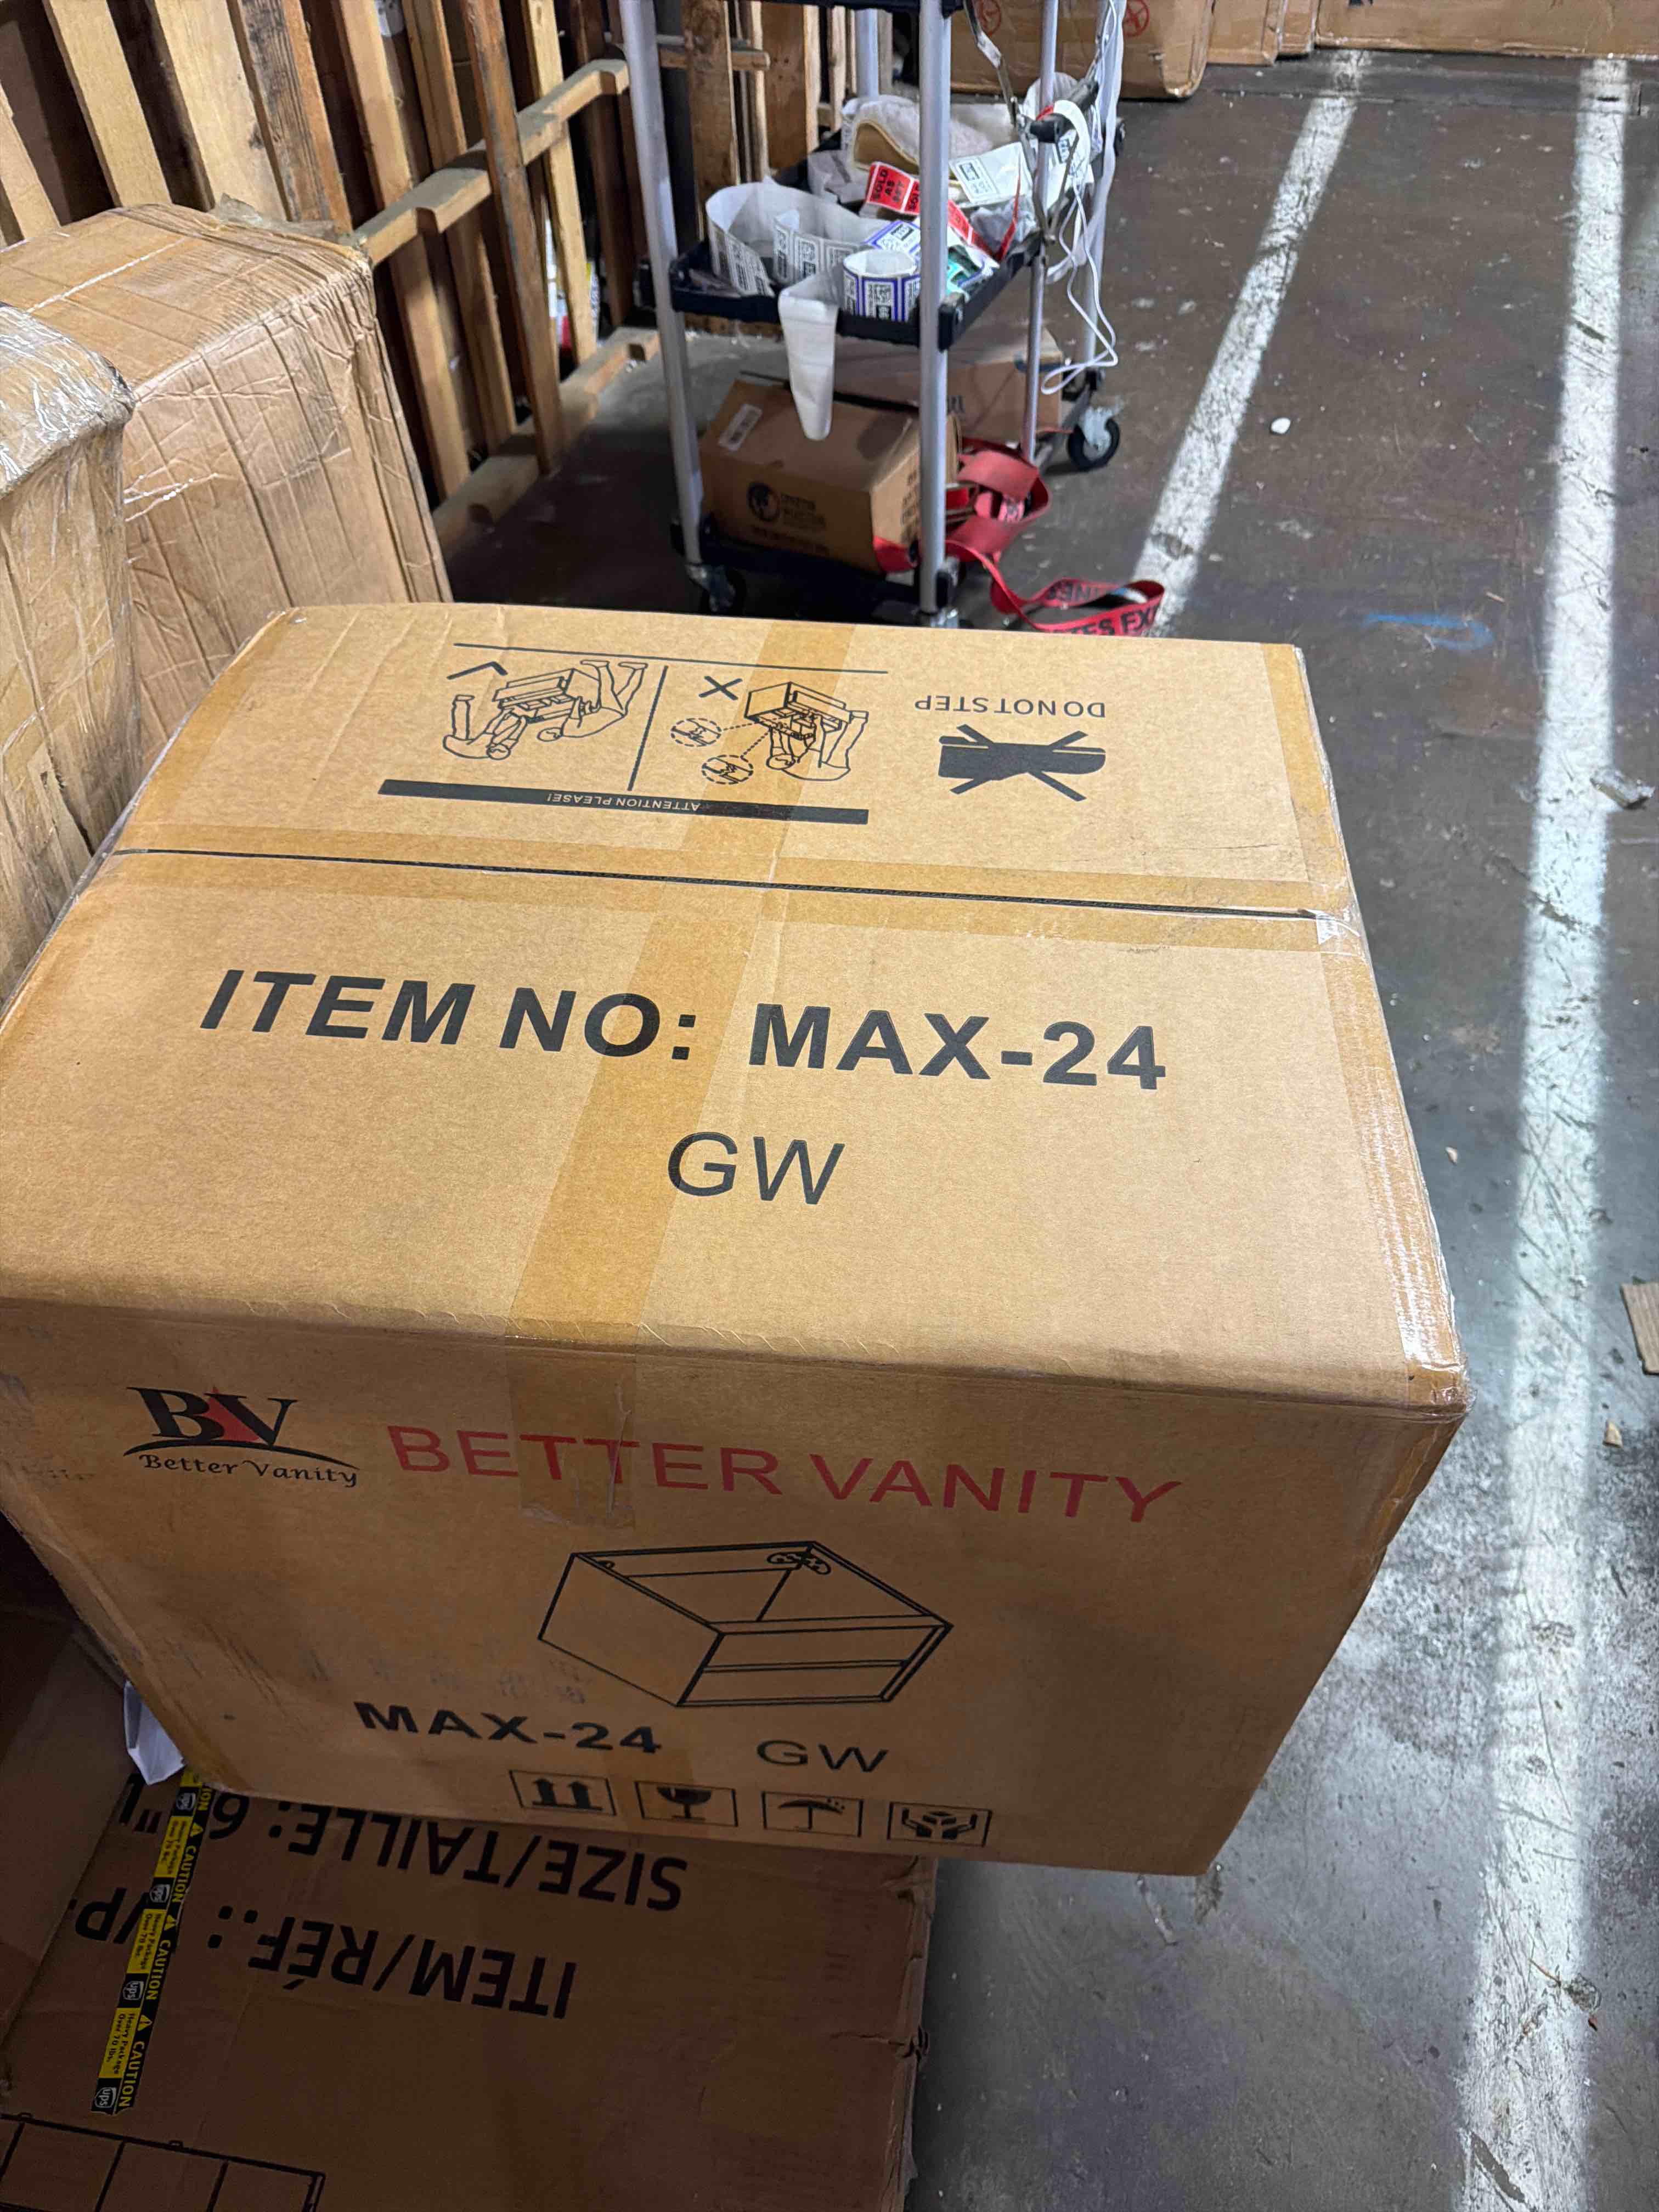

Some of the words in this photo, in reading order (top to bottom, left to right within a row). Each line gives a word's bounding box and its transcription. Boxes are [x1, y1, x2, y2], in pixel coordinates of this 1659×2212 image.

[914, 695, 988, 713] STEP
[994, 697, 1056, 716] NOT
[1063, 700, 1106, 718] DO
[547, 793, 613, 805] PLEASE!
[616, 798, 701, 811] ATTENTION
[199, 968, 476, 1046] ITEM
[499, 987, 697, 1061] NO:
[748, 1003, 1166, 1090] MAX-24
[667, 1131, 845, 1205] GW
[126, 1386, 298, 1446] BV
[139, 1453, 237, 1475] Better
[241, 1459, 358, 1488] Vanity
[386, 1425, 783, 1496] BETTER
[809, 1453, 1182, 1523] VANITY
[354, 1701, 662, 1754] MAX-24
[756, 1739, 889, 1773] GW
[171, 1844, 197, 1904] CAUTION
[145, 1939, 171, 2001] CAUTION
[98, 2089, 112, 2107] ups
[119, 2041, 145, 2107] CAUTION
